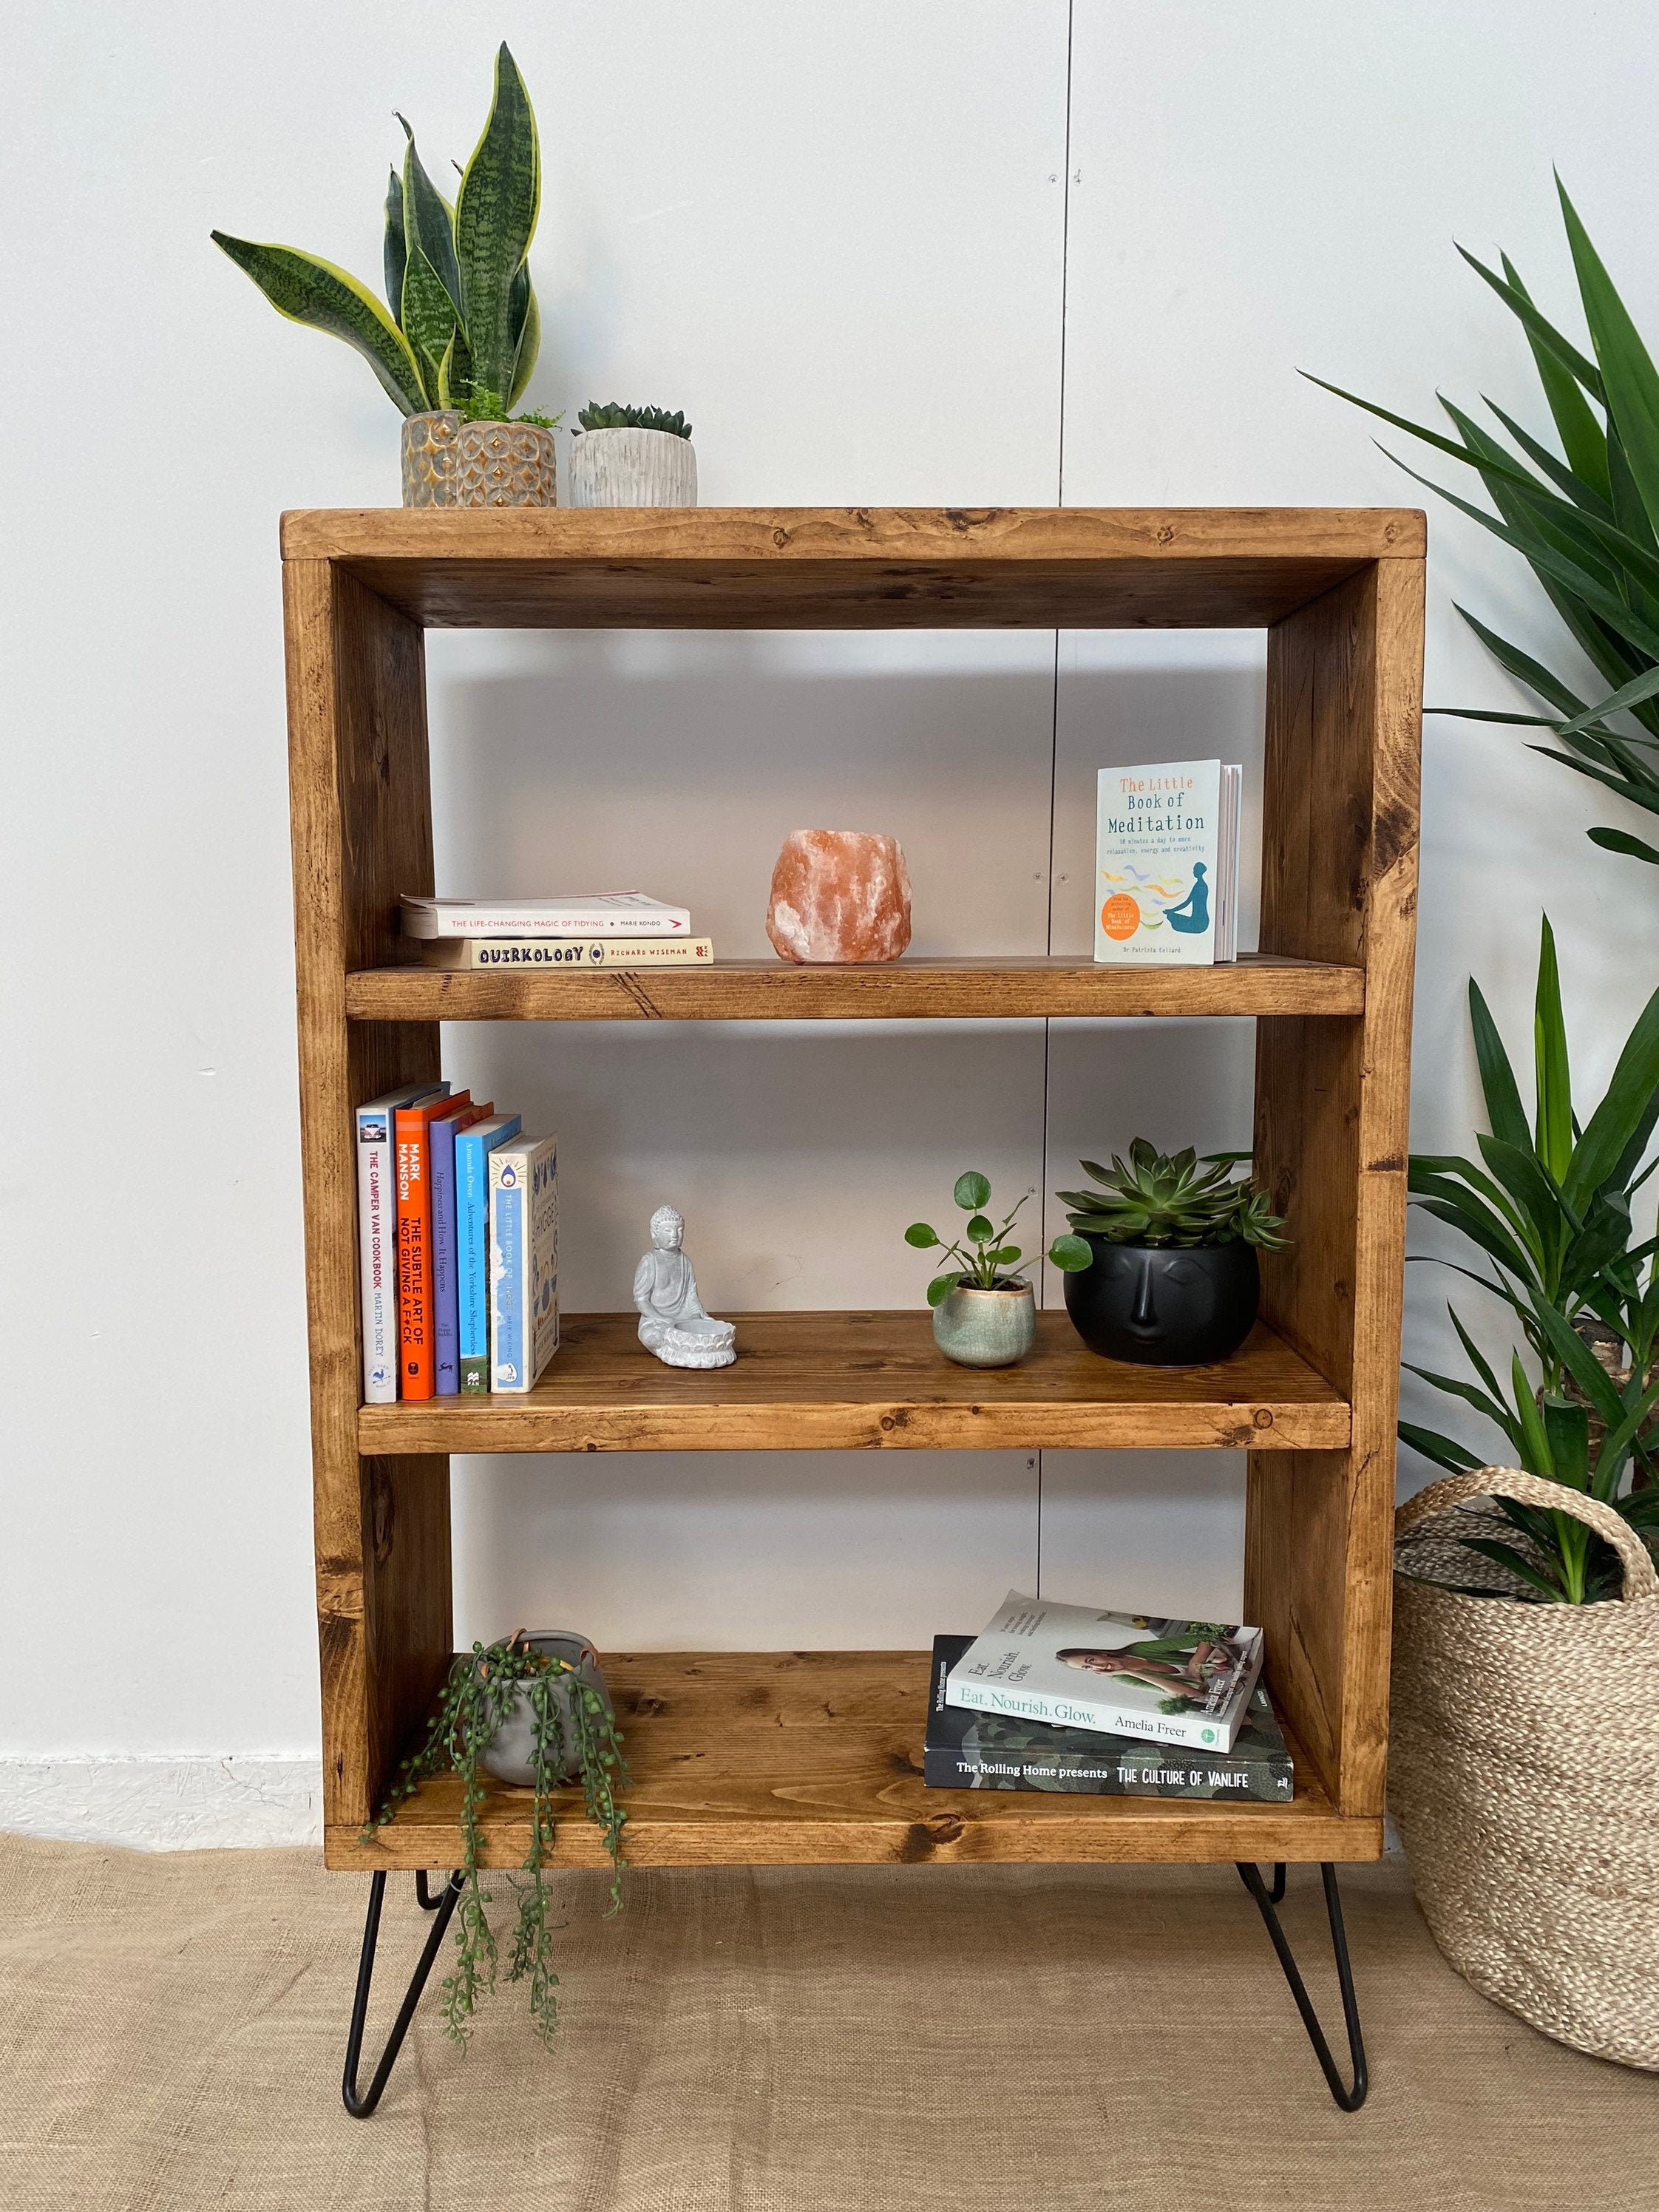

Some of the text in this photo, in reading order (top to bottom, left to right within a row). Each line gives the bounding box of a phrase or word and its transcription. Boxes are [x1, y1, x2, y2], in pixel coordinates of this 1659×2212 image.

[1120, 776, 1192, 793] The Little
[1128, 792, 1184, 810] Book of
[1108, 815, 1204, 833] Meditation
[478, 946, 584, 963] QUIRKOLOGY
[398, 1143, 410, 1201] MANSON
[409, 1143, 421, 1181] MARK
[466, 1143, 475, 1198] Amanda Owen
[434, 1172, 444, 1210] Happiness
[369, 1151, 381, 1289] THE CAMPER VAN COOKBOOK
[438, 1210, 446, 1225] and
[505, 1212, 513, 1237] LITTLE
[535, 1203, 554, 1239] HYGGE
[400, 1218, 410, 1244] NOT
[438, 1225, 447, 1244] How
[401, 1248, 412, 1293] GIVING
[411, 1217, 424, 1345] THE SUBTLE ART OF
[437, 1258, 447, 1292] Happens
[467, 1203, 477, 1355] Adventures of the Yorkshire Shepherdess
[506, 1267, 513, 1278] OF
[401, 1297, 412, 1306] A
[374, 1292, 384, 1357] MARTIN DOREY
[968, 1663, 990, 1676] Eat.
[987, 1652, 1020, 1679] Nourish.
[1008, 1663, 1033, 1682] Glow.
[936, 1703, 944, 1711] The
[960, 1688, 1096, 1724] Eat. Nourish. Glow.
[1200, 1678, 1225, 1715] Amelia Freer
[1115, 1716, 1187, 1737] Amelia Freer
[957, 1762, 1108, 1779] The Rolling Home presents
[1116, 1767, 1249, 1788] THE CULTURE OF VANLIFE
